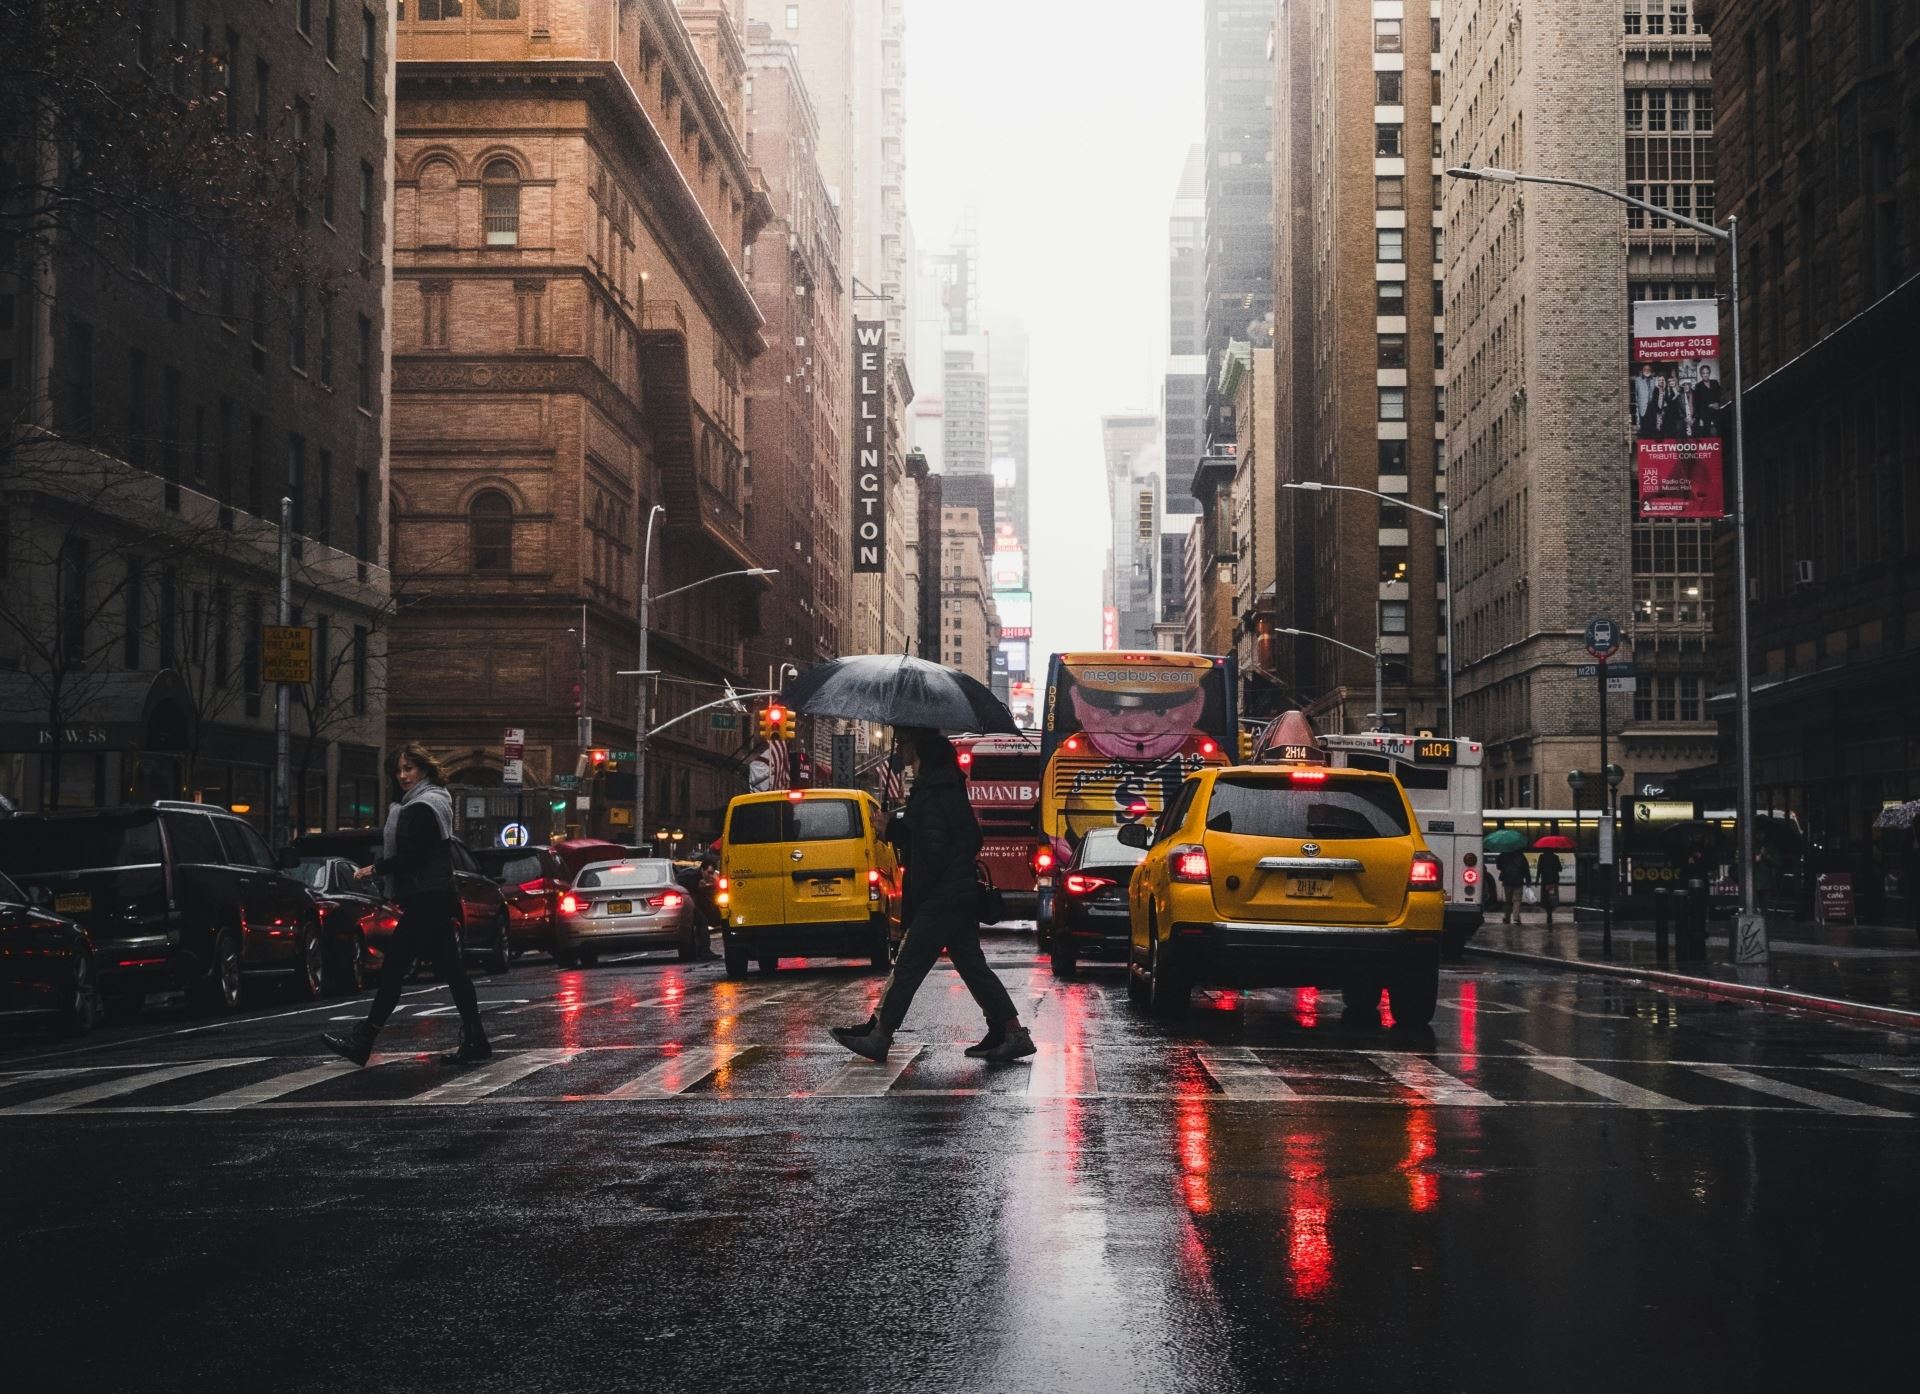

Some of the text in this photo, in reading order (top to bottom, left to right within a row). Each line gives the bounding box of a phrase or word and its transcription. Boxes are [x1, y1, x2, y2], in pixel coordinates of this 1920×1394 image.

[1656, 316, 1697, 330] NYC
[1639, 338, 1712, 348] MusiCares 2018
[1639, 347, 1716, 358] Person of the Year
[856, 328, 883, 564] WELLINGTON
[1640, 442, 1720, 452] FLEETWOOD MAC
[1643, 476, 1658, 485] 26
[1679, 478, 1691, 486] City
[1578, 666, 1597, 676] M20
[1083, 669, 1195, 686] megabus.com
[1047, 685, 1057, 732] DD769
[87, 729, 107, 744] 58
[1355, 740, 1367, 748] City
[1380, 743, 1405, 754] 6700
[1285, 746, 1306, 759] 2H14
[1422, 743, 1450, 757] M104
